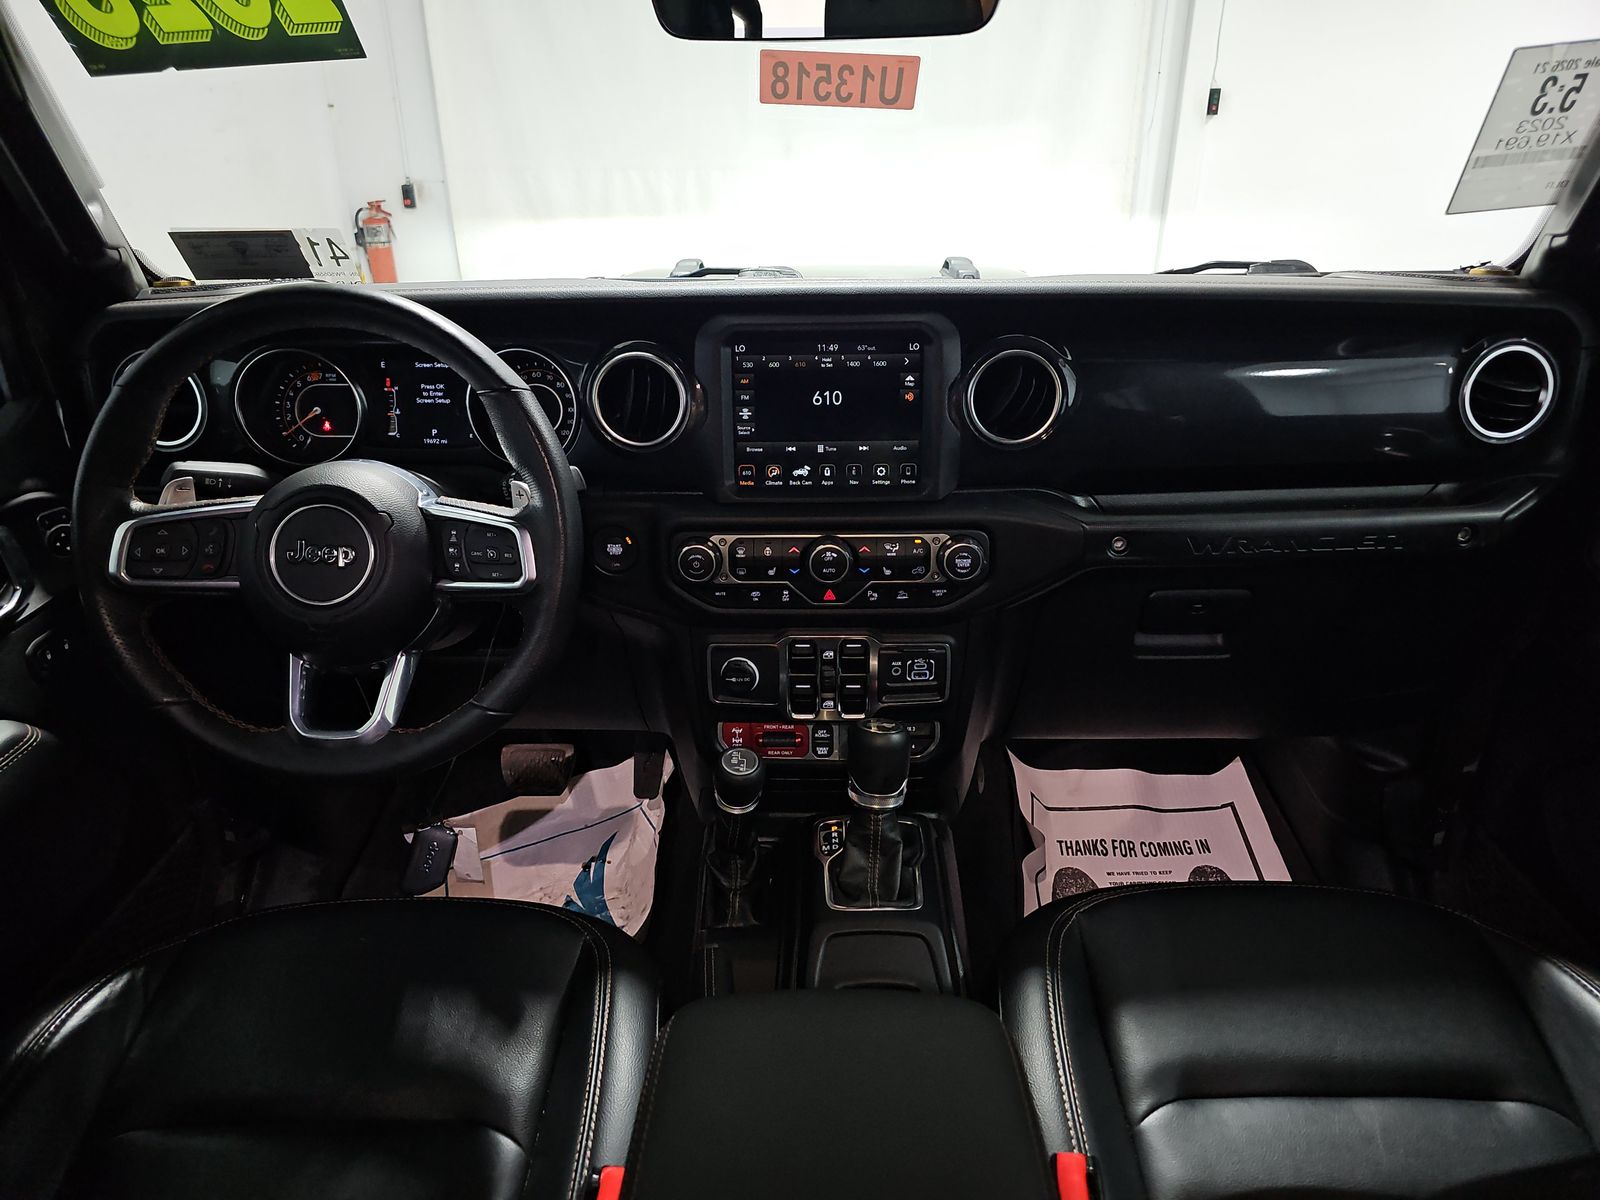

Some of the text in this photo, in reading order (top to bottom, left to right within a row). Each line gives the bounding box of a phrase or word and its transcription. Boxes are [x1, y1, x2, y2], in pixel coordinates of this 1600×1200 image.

[812, 390, 842, 406] 610
[286, 540, 356, 567] Jeep
[1056, 838, 1212, 858] THANKS FOR COMING IN
